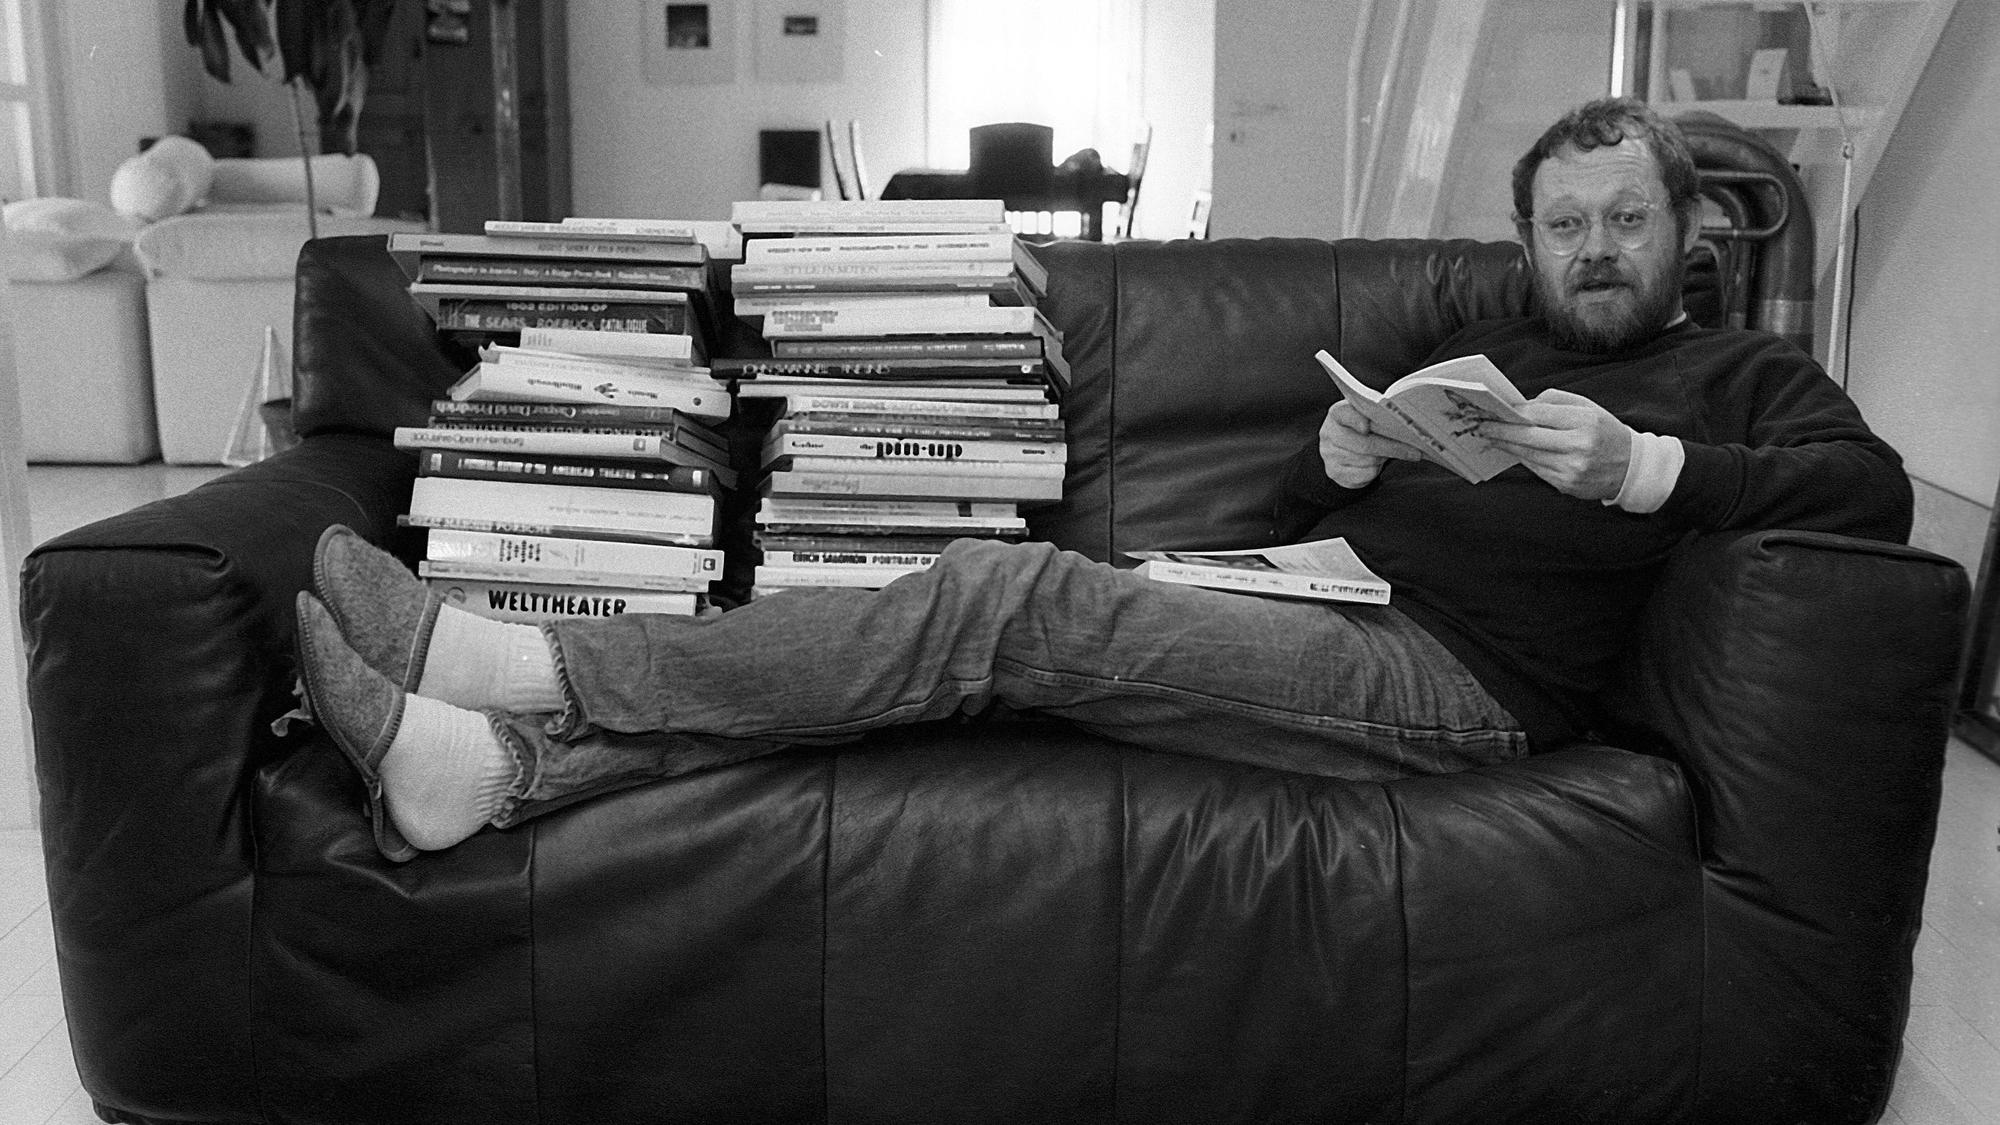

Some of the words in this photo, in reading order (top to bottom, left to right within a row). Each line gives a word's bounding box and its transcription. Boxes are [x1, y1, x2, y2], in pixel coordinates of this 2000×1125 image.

[433, 263, 479, 276] Photography
[489, 265, 517, 275] America
[783, 262, 820, 275] STYLE
[822, 262, 836, 275] IN
[837, 262, 880, 274] MOTION
[538, 302, 589, 312] EDITION
[591, 303, 608, 312] OF
[536, 317, 596, 332] ROEBUCK
[436, 403, 493, 416] Friedrich
[495, 404, 531, 417] David
[532, 404, 577, 418] Caspar
[811, 400, 848, 410] DOWN
[876, 441, 964, 458] pin-up
[793, 553, 820, 563] ERICH
[822, 554, 867, 565] SALOMON
[872, 555, 919, 566] PORTRAIT
[921, 555, 932, 566] OF
[488, 589, 627, 617] WELTTHEATER
